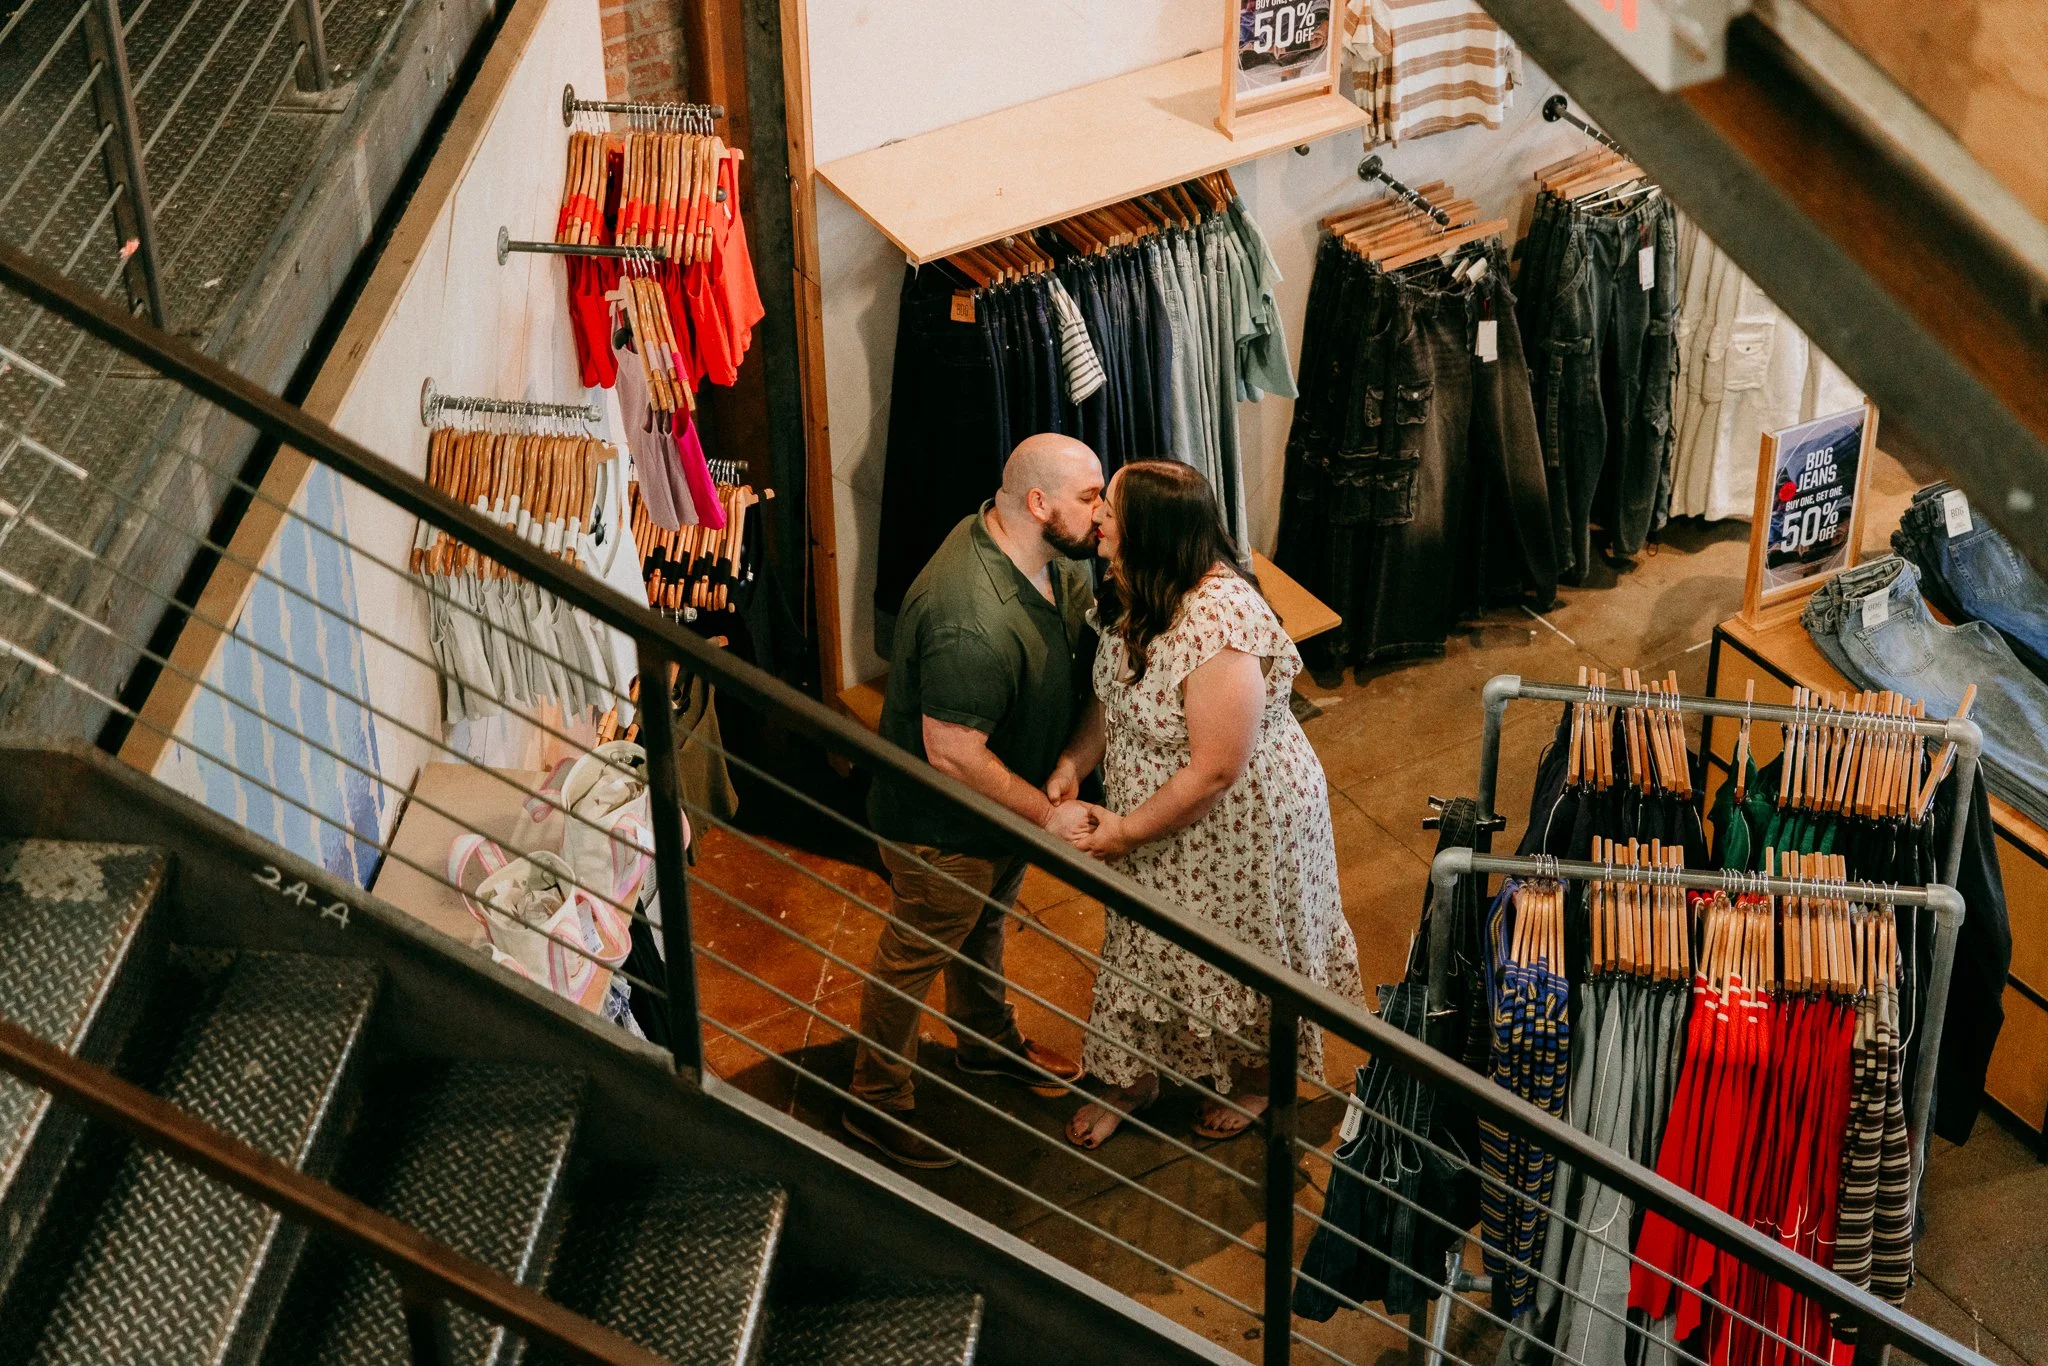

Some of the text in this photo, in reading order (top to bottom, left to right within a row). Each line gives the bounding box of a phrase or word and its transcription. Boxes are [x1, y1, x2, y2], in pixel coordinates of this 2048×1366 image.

[1255, 0, 1270, 10] BUY
[1253, 1, 1316, 54] 50%
[1295, 27, 1315, 44] OFF
[1805, 446, 1834, 471] BDG
[1796, 464, 1838, 492] JEANS
[1785, 499, 1800, 512] BUY
[1815, 490, 1829, 502] GET
[1829, 485, 1843, 498] ONE
[1780, 499, 1839, 553] 50%
[1818, 524, 1838, 542] OFF
